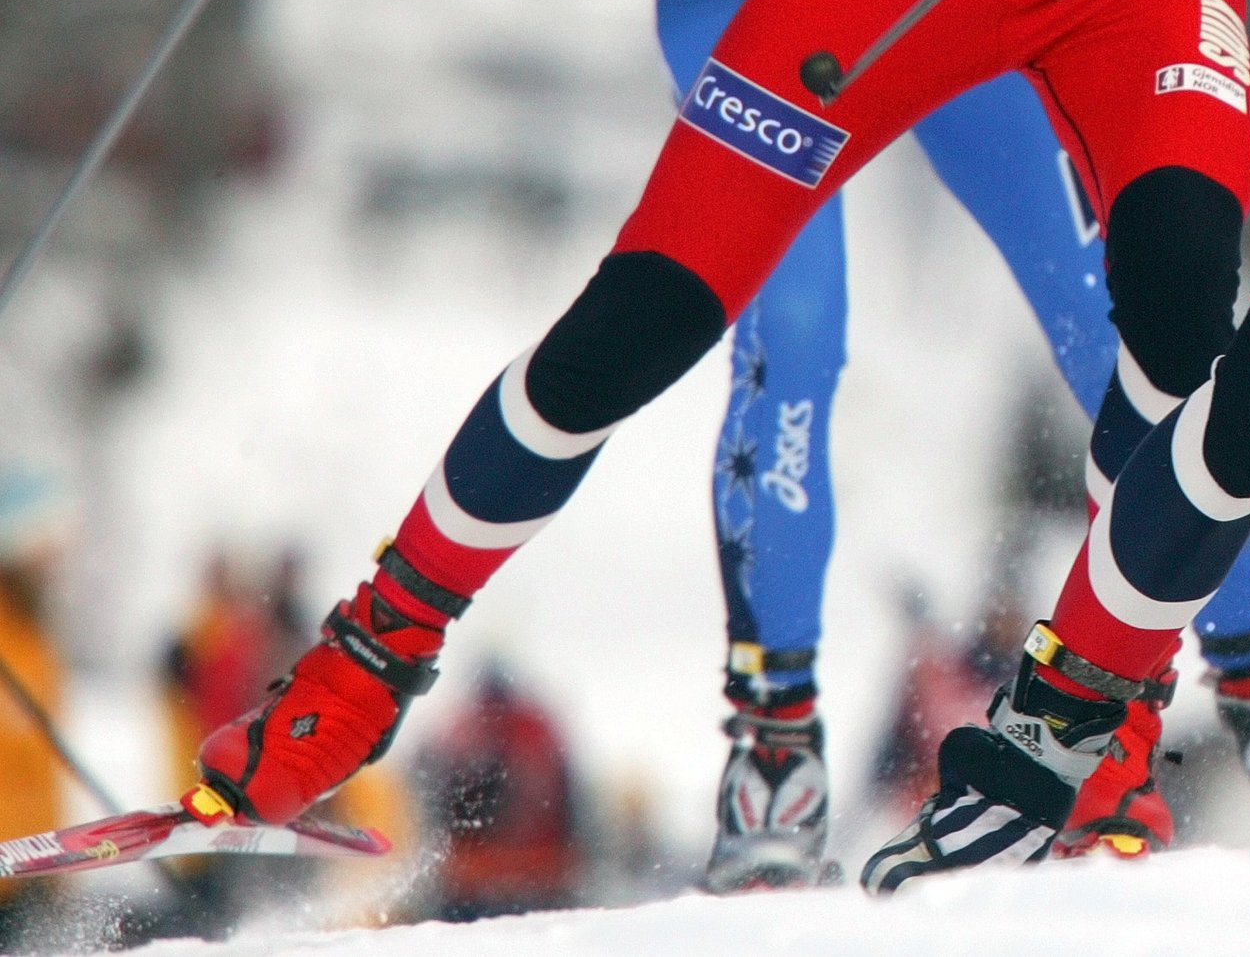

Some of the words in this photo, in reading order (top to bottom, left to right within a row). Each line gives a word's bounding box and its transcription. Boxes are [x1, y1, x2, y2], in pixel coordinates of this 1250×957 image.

[1193, 79, 1219, 95] NOR
[694, 75, 803, 155] Cresco
[1006, 724, 1044, 757] adidas
